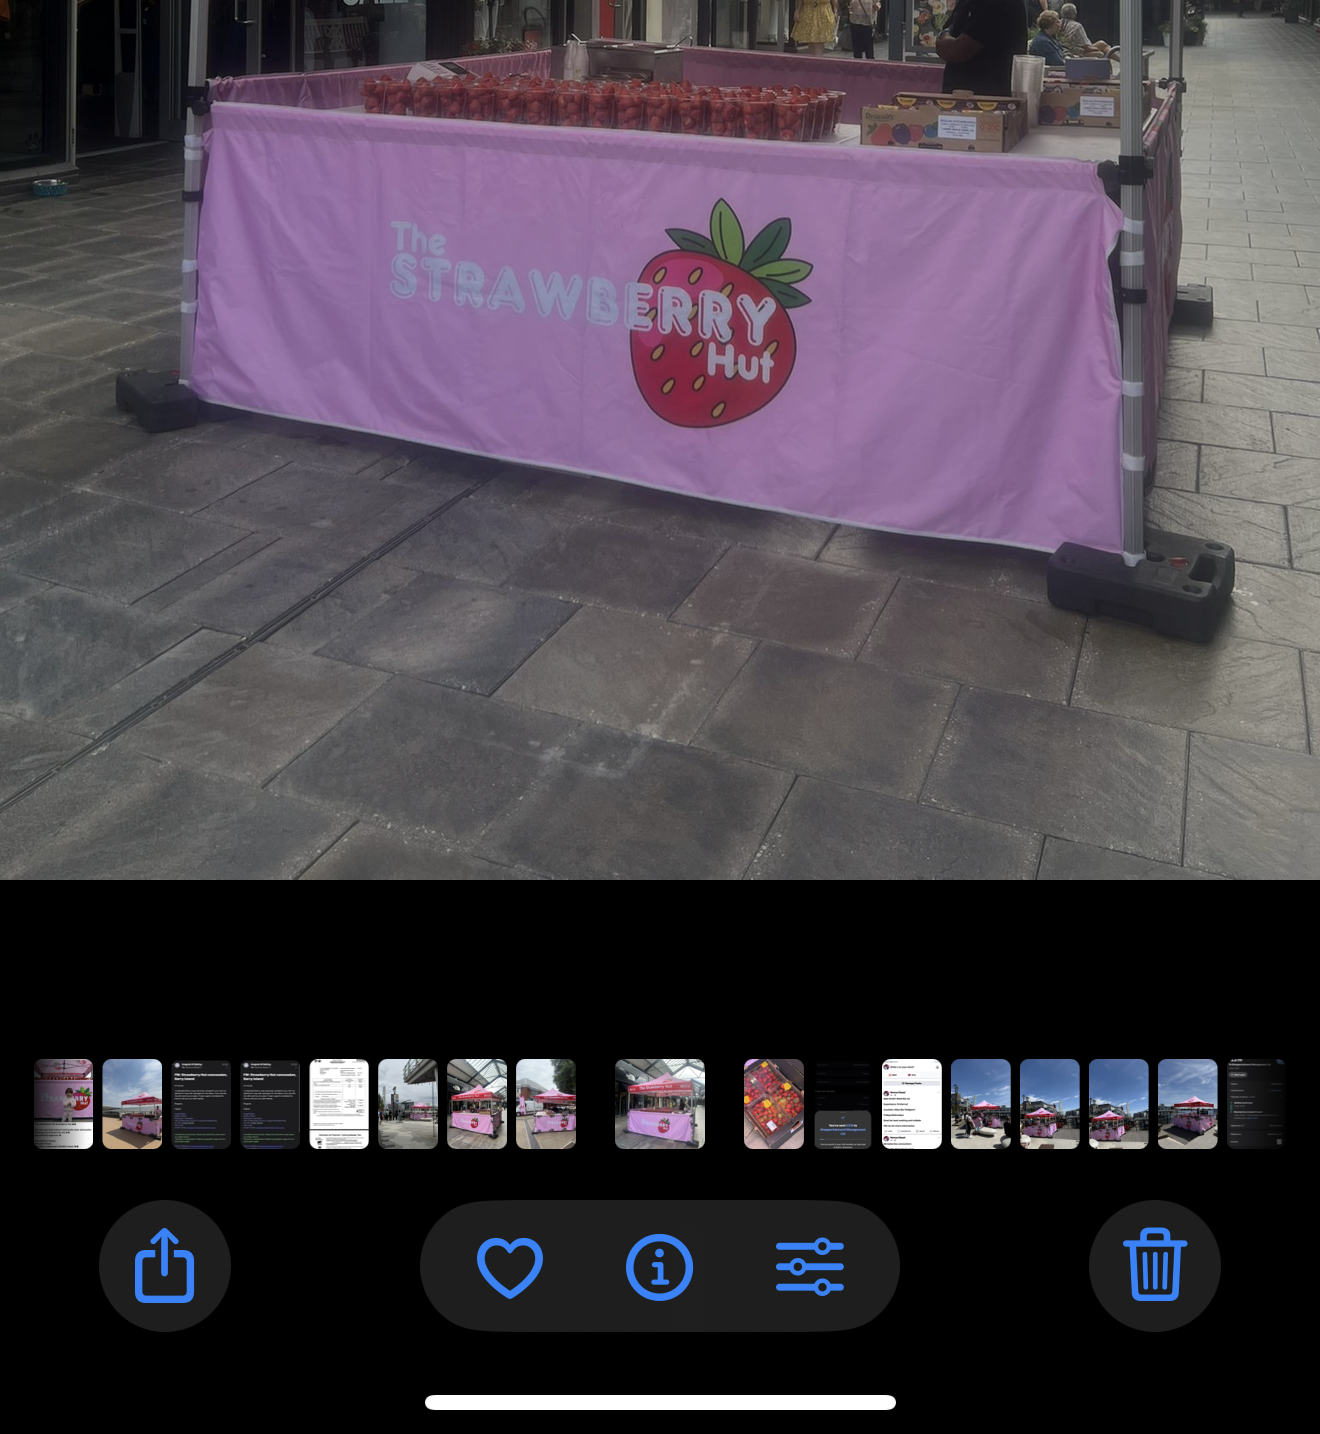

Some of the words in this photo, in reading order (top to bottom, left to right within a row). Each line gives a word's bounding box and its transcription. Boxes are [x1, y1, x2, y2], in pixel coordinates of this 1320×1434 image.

[390, 220, 446, 256] The
[390, 253, 776, 347] STRAWBERRY
[706, 341, 775, 384] Hut
